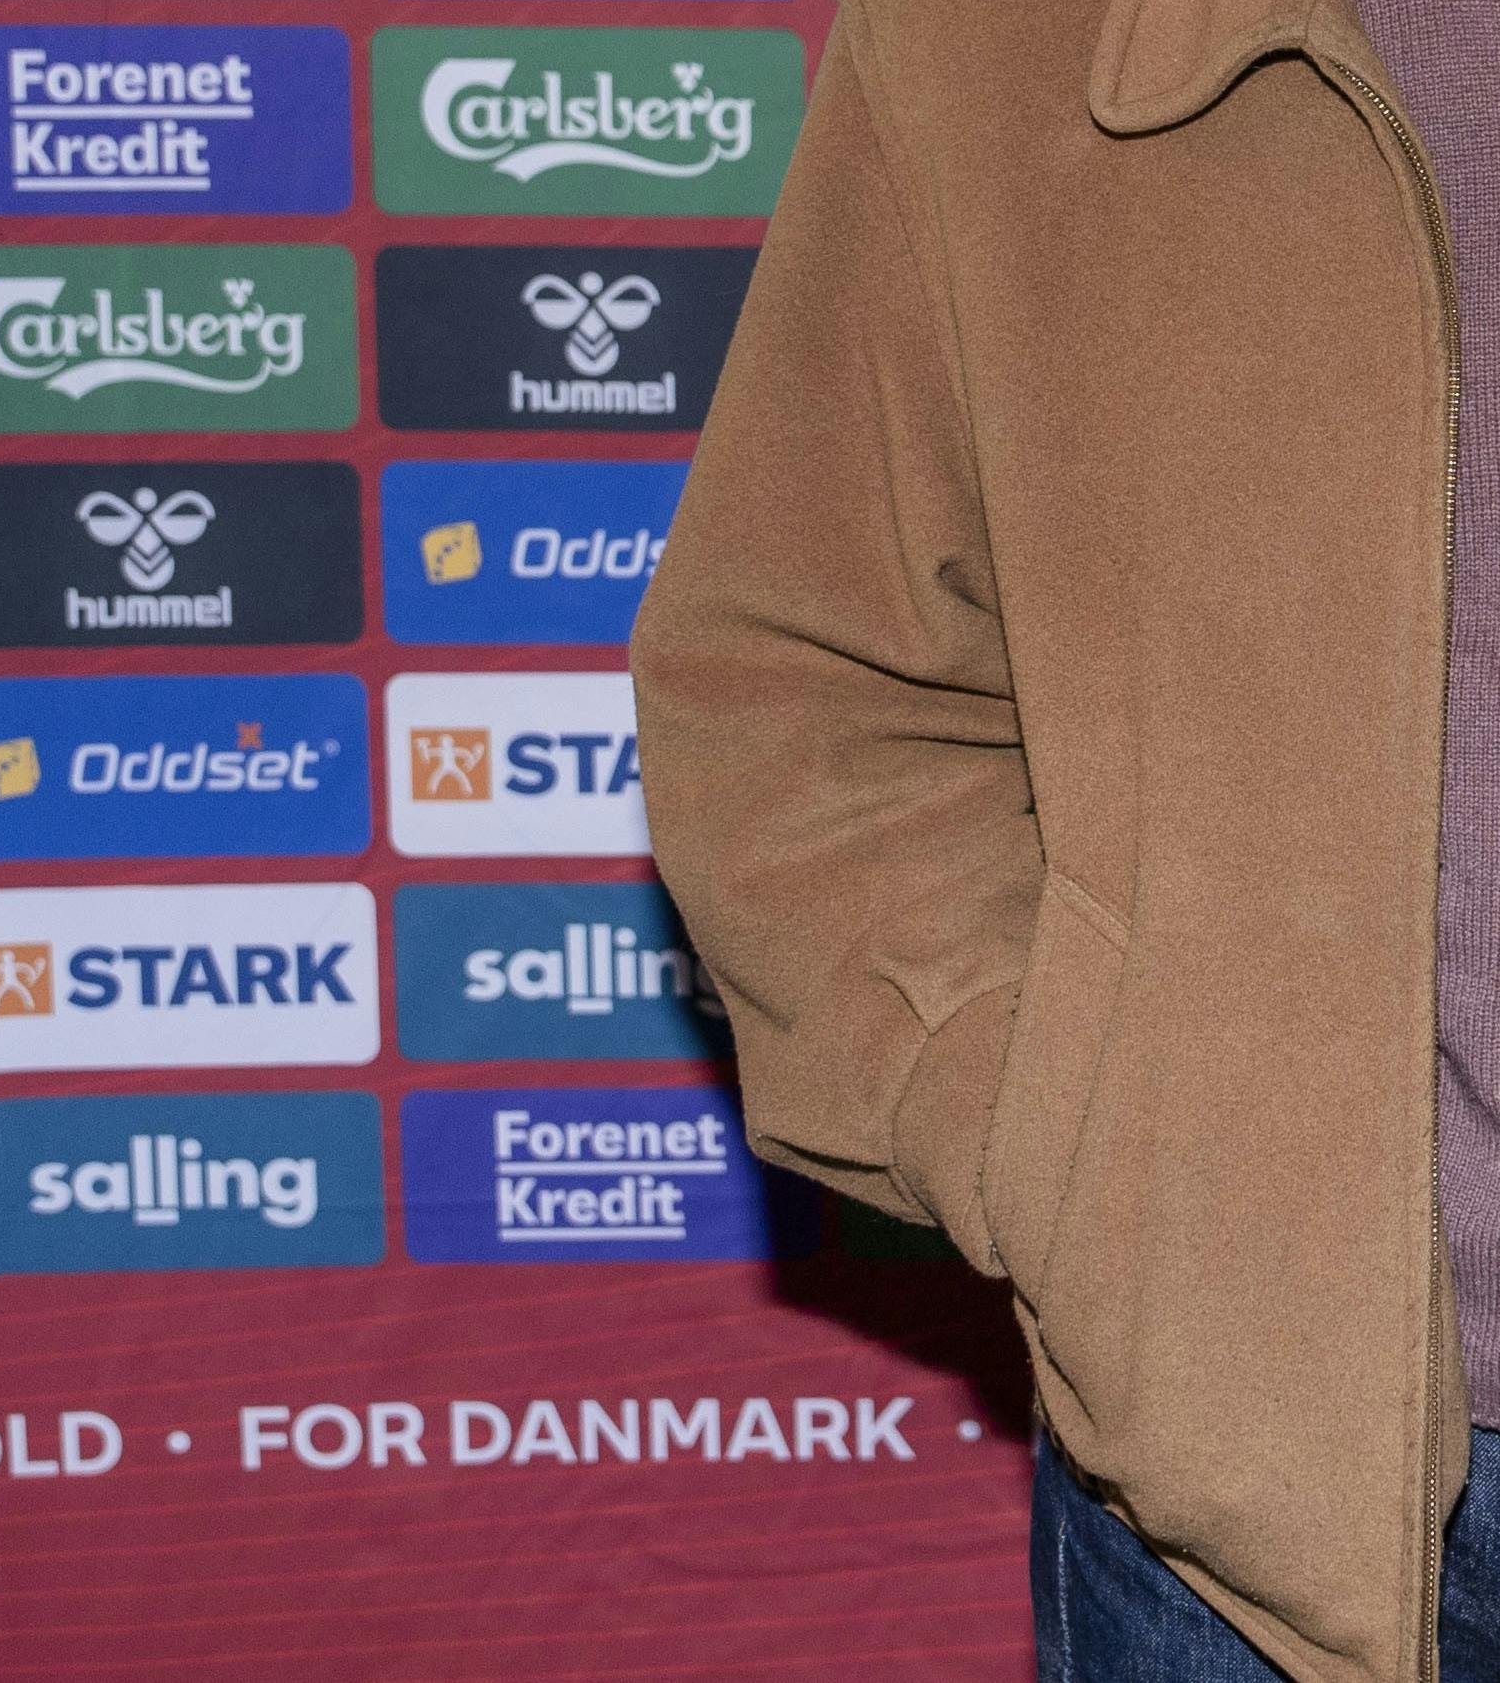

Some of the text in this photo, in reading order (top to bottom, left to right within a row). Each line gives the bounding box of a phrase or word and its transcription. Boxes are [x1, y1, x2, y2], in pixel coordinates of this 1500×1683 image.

[10, 50, 252, 102] Forenet
[420, 58, 753, 182] Carlsberg
[13, 120, 209, 174] Kredit
[510, 370, 677, 414] hummel
[65, 585, 233, 628] hummel
[66, 943, 354, 1011] STARK
[495, 1110, 725, 1159] Forenet
[30, 1134, 318, 1228] salling
[497, 1174, 684, 1225] Kredit
[239, 1401, 427, 1471] FOR
[449, 1396, 915, 1465] DANMARK
